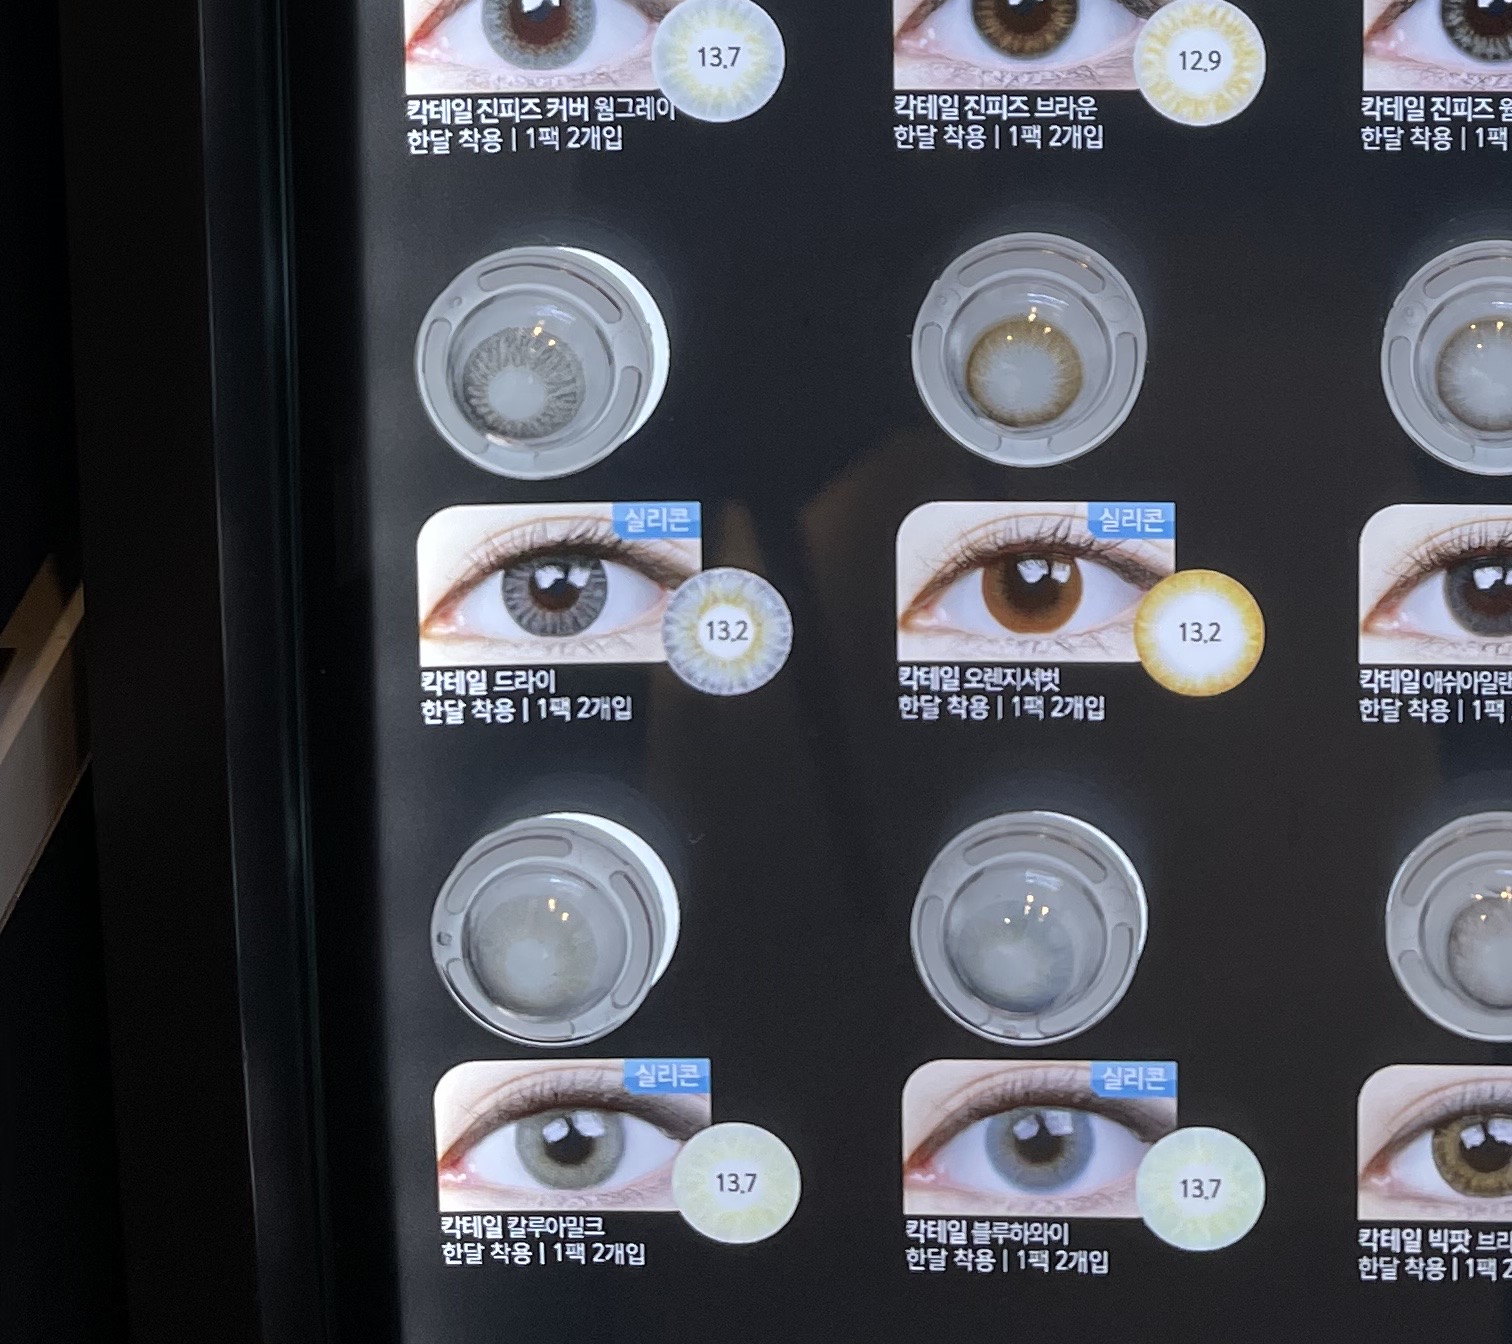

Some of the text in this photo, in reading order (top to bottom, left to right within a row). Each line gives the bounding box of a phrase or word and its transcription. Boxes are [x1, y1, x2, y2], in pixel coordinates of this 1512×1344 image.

[698, 47, 740, 69] 13.7
[1179, 50, 1221, 73] 12.9
[408, 96, 676, 125] 칵테일 진피즈 커버 웜그레이
[894, 94, 1098, 121] 칵테일 진피즈 브라운
[1361, 96, 1425, 122] 칵테일
[1430, 97, 1494, 122] 진피즈
[894, 125, 1104, 150] 한달 착용 1팩 2개입
[625, 508, 692, 533] 실리콘
[1100, 508, 1164, 533] 실리콘
[706, 620, 748, 642] 13.2
[1179, 622, 1221, 644] 13.2
[422, 670, 556, 696] 칵테일 드라이
[900, 666, 1060, 692] 칵테일 오렌지셔벗
[1360, 669, 1420, 695] 칵테일
[1359, 699, 1402, 723] 한달
[1408, 699, 1450, 724] 착용
[1473, 700, 1505, 724] 1팩
[635, 1064, 700, 1088] 실리콘
[1103, 1066, 1167, 1091] 실리콘
[716, 1173, 757, 1194] 13.7
[1180, 1179, 1221, 1200] 13.7
[441, 1216, 605, 1239] 칵테일 칼루아밀크
[906, 1220, 1069, 1246] 칵테일 블루하와이
[1358, 1228, 1422, 1254] 칵테일
[1428, 1229, 1472, 1255] 빅팟
